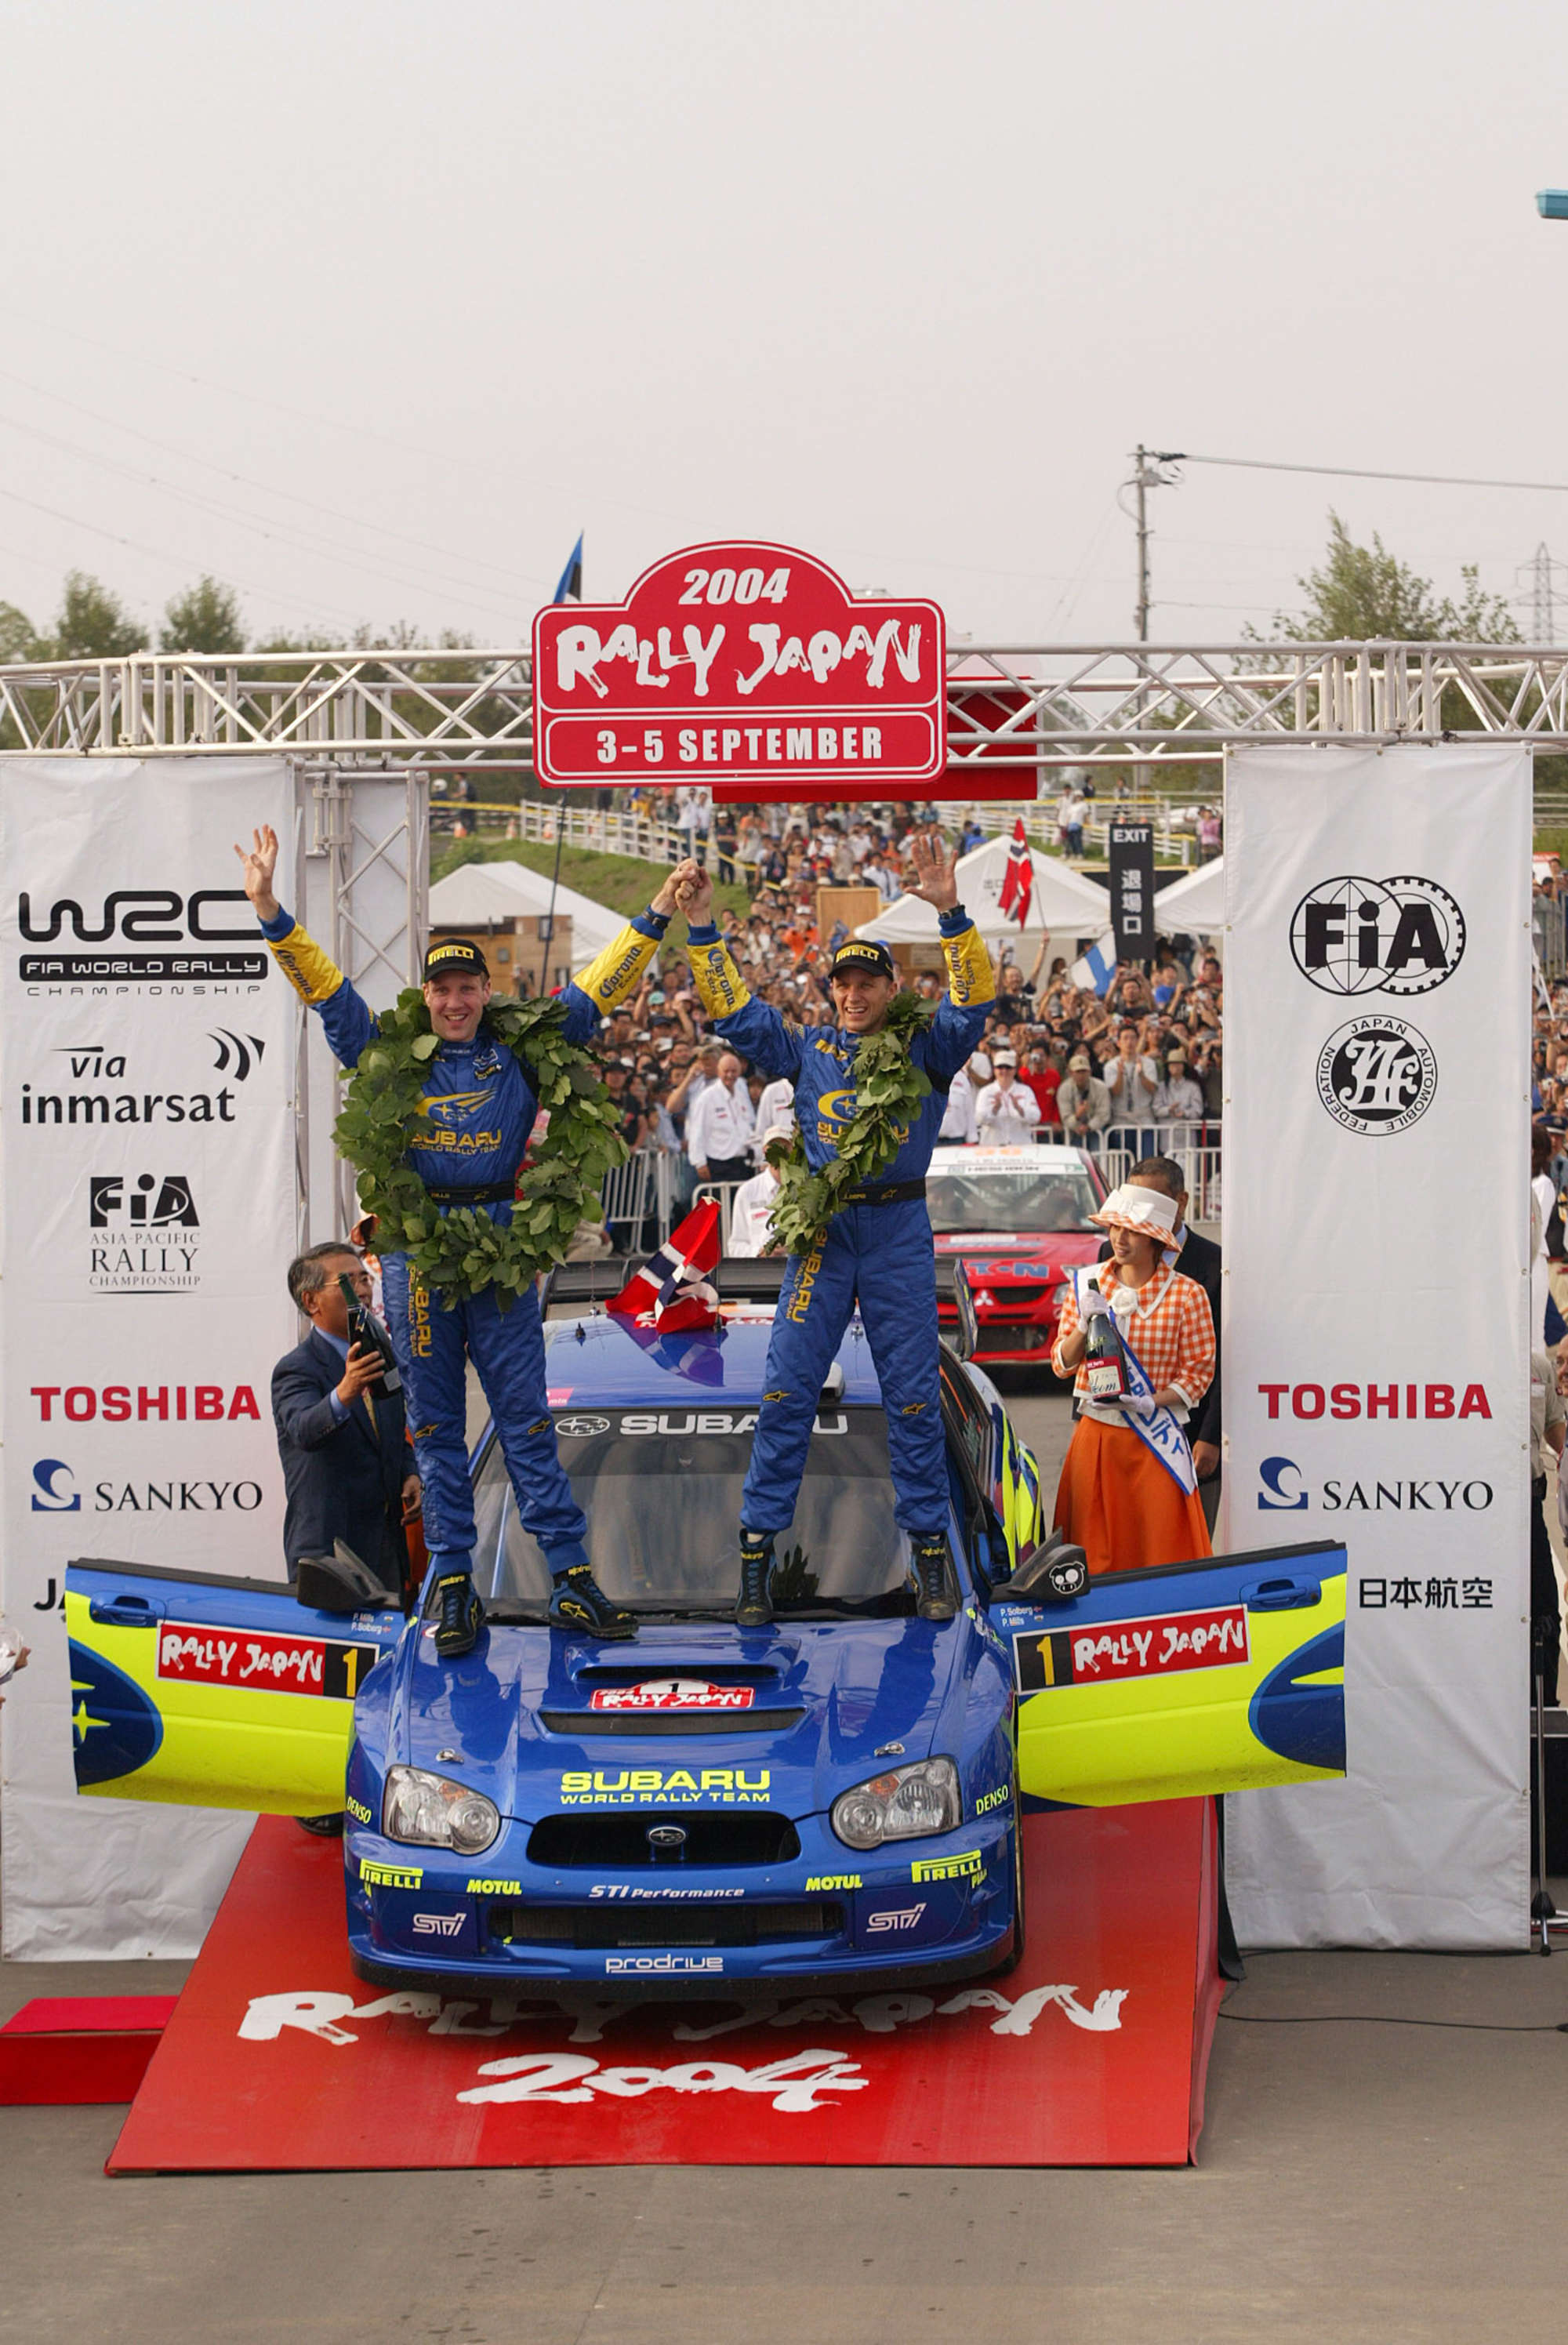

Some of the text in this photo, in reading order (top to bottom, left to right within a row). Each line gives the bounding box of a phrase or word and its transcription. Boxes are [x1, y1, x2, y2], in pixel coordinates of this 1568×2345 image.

[679, 568, 790, 605] 2004
[556, 619, 922, 699] RALLY JAPAN
[679, 727, 883, 762] SEPTEMBER
[1112, 829, 1150, 844] EXIT
[19, 891, 265, 942] WRC
[27, 960, 262, 975] FIA WORLD RALLY
[599, 946, 643, 1000] Corona
[708, 948, 736, 1008] Corona
[27, 986, 261, 996] CHAMPIONSHIP
[63, 1047, 127, 1079] via
[1319, 1018, 1434, 1131] JAPAN AUTOMOBILE FEDERATION
[22, 1084, 235, 1124] inmarsat
[90, 1233, 200, 1244] ASIA-PACIFIC
[90, 1249, 199, 1272] RALLY
[89, 1276, 201, 1286] CHAMPIONSHIP
[415, 1283, 433, 1358] BARU
[31, 1386, 261, 1421] TOSHIBA
[1258, 1384, 1493, 1419] TOSHIBA
[620, 1414, 849, 1435] SUBAU
[95, 1480, 263, 1512] SANKYO
[1323, 1480, 1494, 1510] SANKYO
[33, 1578, 66, 1611] J
[1359, 1577, 1494, 1609] 日本航空
[162, 1634, 358, 1697] RALLY JAPAN 1
[1036, 1619, 1243, 1686] 1 RALLY JAPAN
[601, 1693, 743, 1708] RALLY JAPAN
[669, 1683, 680, 1693] 1
[561, 1770, 771, 1792] SUBARU
[347, 1795, 372, 1824] DENSO
[561, 1792, 771, 1805] WORLD RALLY TEAM
[975, 1784, 1009, 1816] DENSO
[359, 1858, 424, 1890] PIRELLI
[911, 1849, 982, 1883] PIRELLI
[466, 1879, 522, 1895] MOTUL
[589, 1886, 745, 1899] STI Performance
[805, 1875, 862, 1891] MOTUL
[605, 1954, 724, 1973] prodrive
[238, 1984, 1130, 2045] RALLY JAPAN
[456, 2048, 869, 2112] 2004
